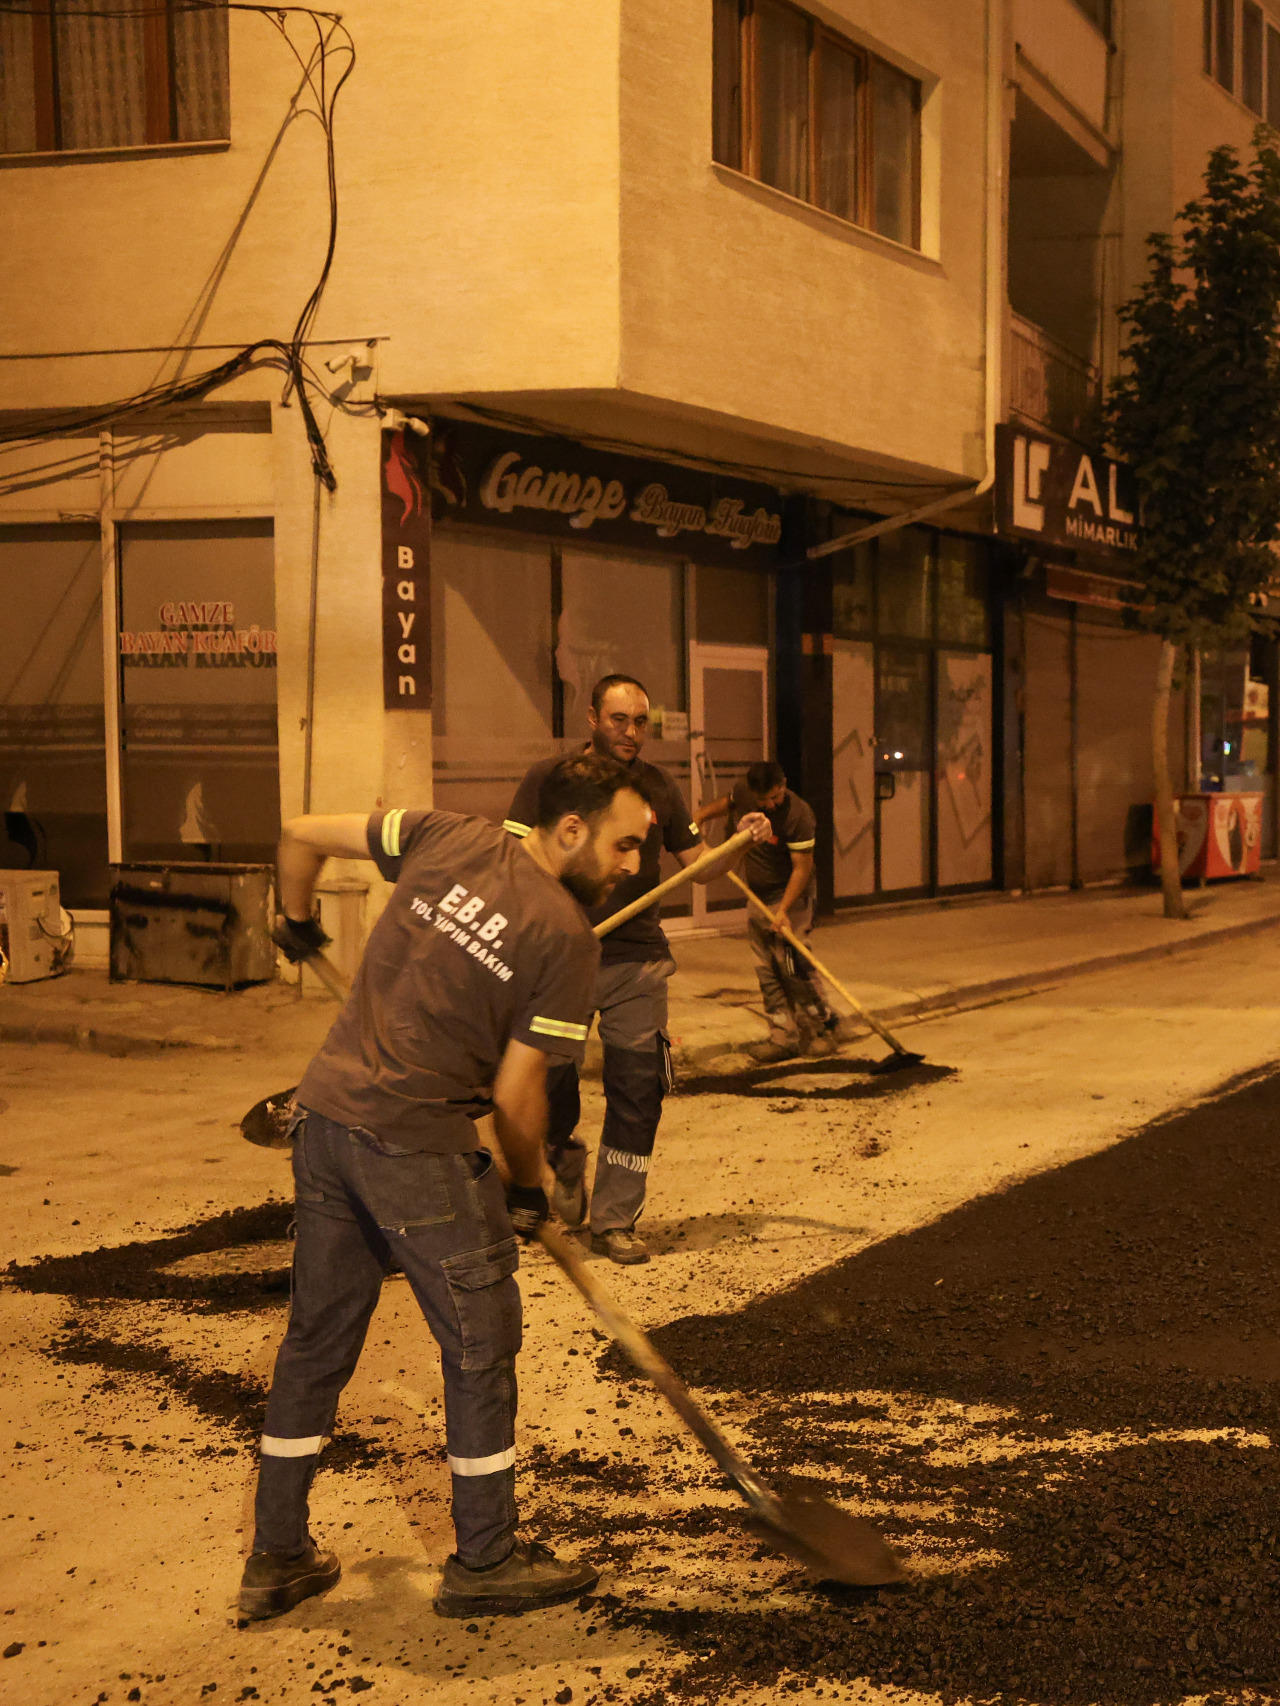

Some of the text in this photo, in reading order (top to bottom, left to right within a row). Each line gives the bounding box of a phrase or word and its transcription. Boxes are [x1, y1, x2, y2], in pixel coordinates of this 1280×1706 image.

[480, 452, 627, 529] Gamze
[630, 483, 706, 537] Bayan
[120, 624, 278, 654] BAYAN KUAFÖR
[160, 601, 235, 625] GAMZE
[397, 546, 416, 695] Bayan
[410, 897, 514, 982] YOL YAPIM BAKIM
[437, 883, 509, 950] E.B.B.
